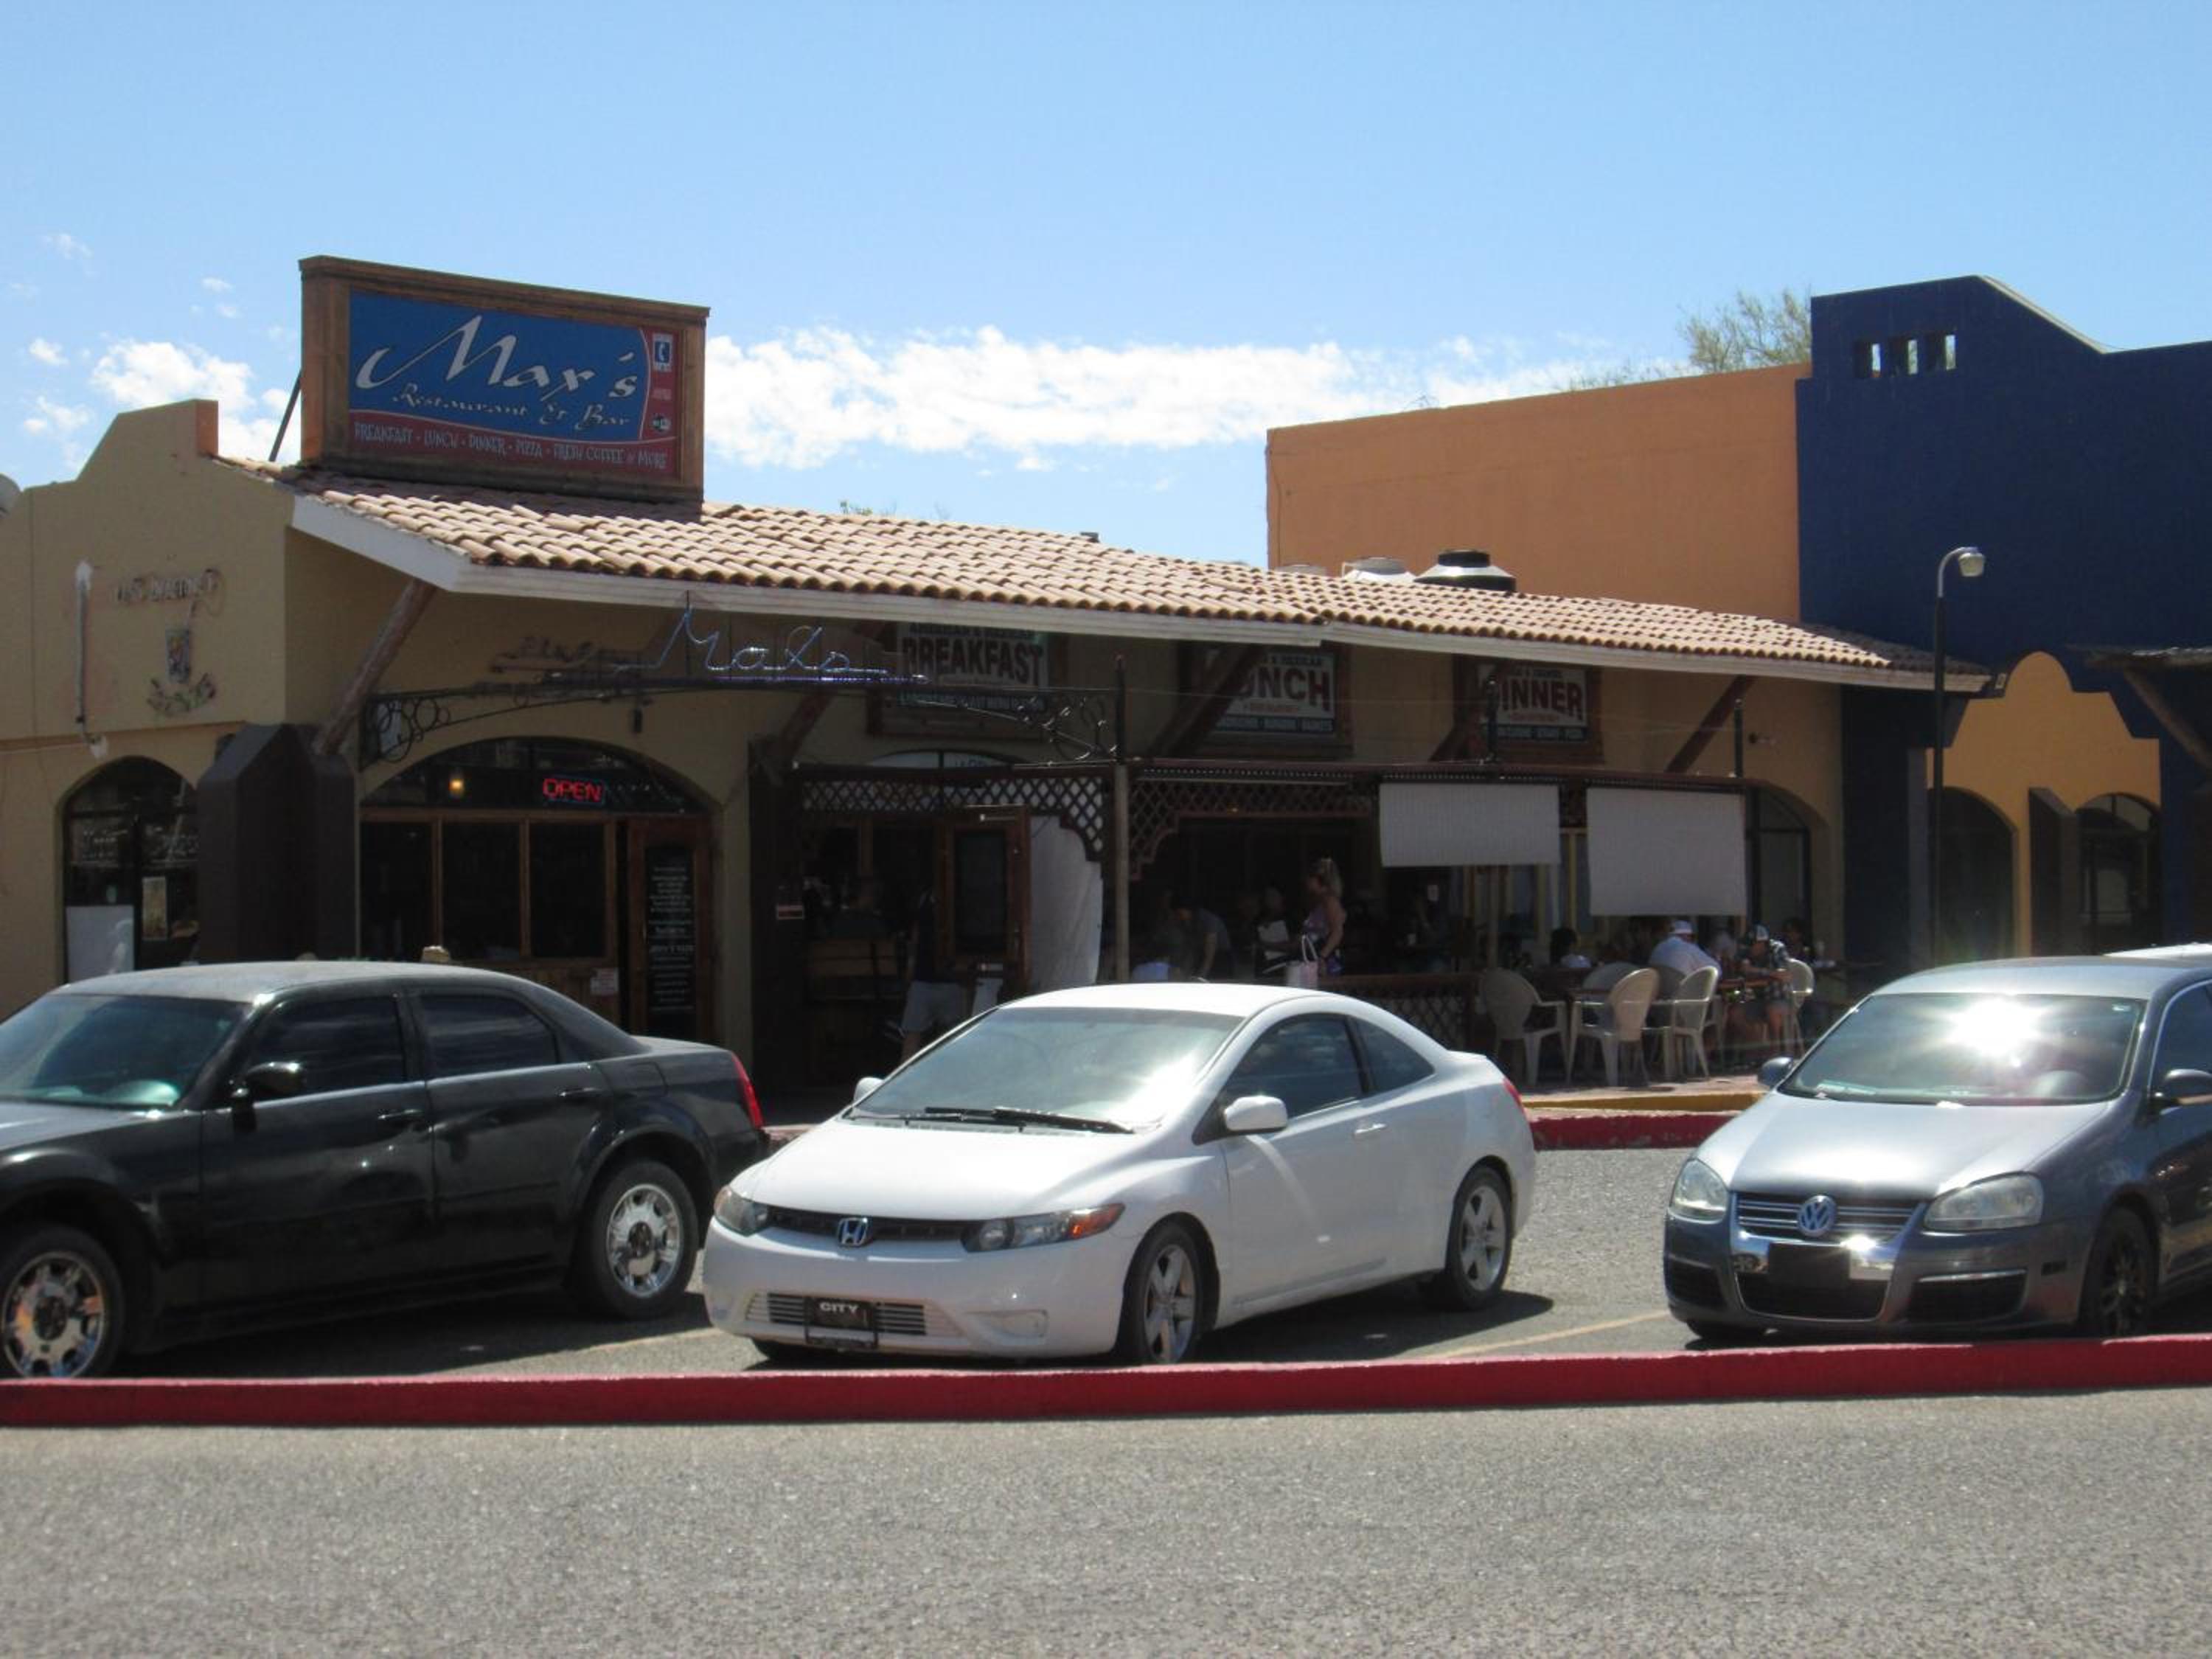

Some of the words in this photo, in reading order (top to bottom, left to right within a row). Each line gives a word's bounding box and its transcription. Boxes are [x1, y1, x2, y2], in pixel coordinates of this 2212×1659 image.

[355, 315, 639, 402] Max's
[574, 403, 630, 431] Bar
[901, 638, 1044, 686] BREAKFAST
[1498, 678, 1583, 720] INNER
[541, 777, 604, 803] OPEN
[819, 1301, 860, 1314] CITY
